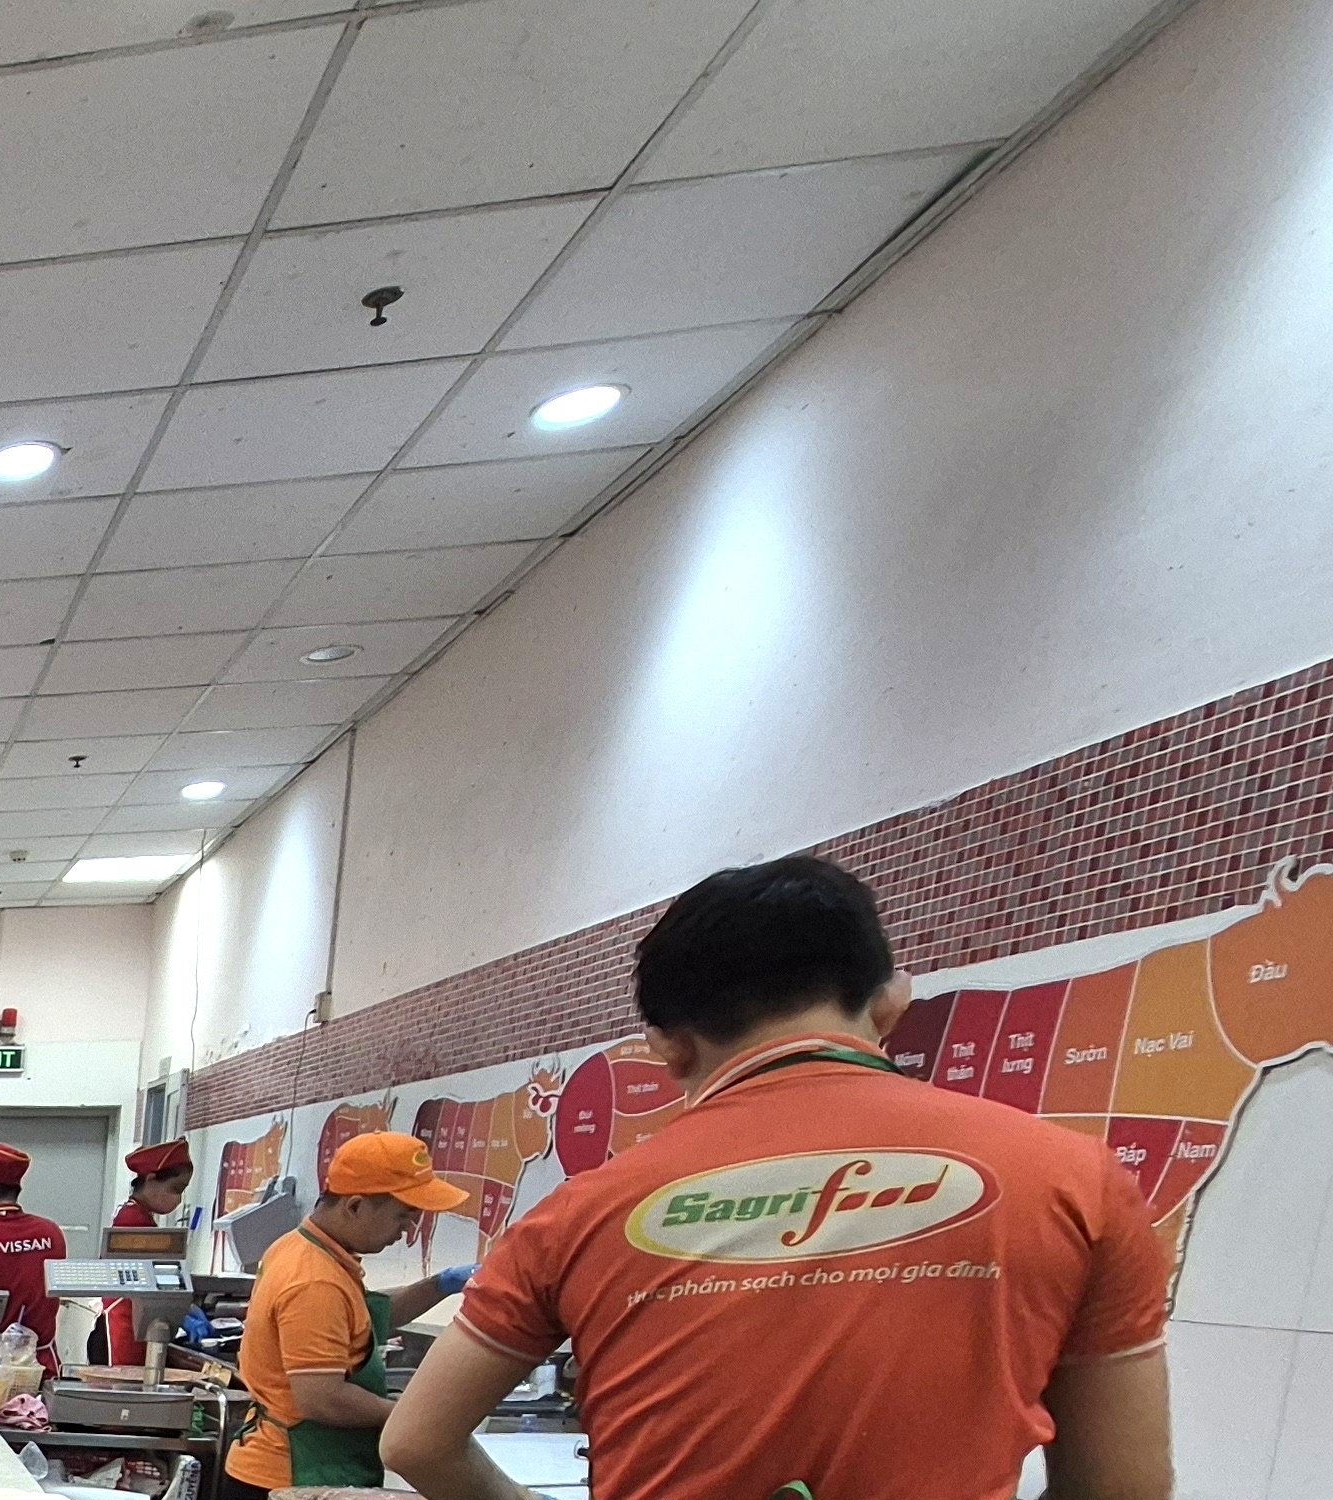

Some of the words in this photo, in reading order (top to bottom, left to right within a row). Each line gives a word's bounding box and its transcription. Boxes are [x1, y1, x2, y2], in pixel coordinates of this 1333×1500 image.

[1248, 959, 1288, 984] Đầu
[1134, 1036, 1164, 1057] Nạc
[1169, 1031, 1193, 1051] Vai
[663, 1160, 949, 1247] Sagrifood
[670, 1274, 735, 1301] phẩm
[741, 1270, 795, 1293] sạch
[800, 1268, 844, 1287] cho
[850, 1262, 896, 1284] mọi
[902, 1262, 941, 1285] gia
[946, 1259, 1001, 1281] đình
